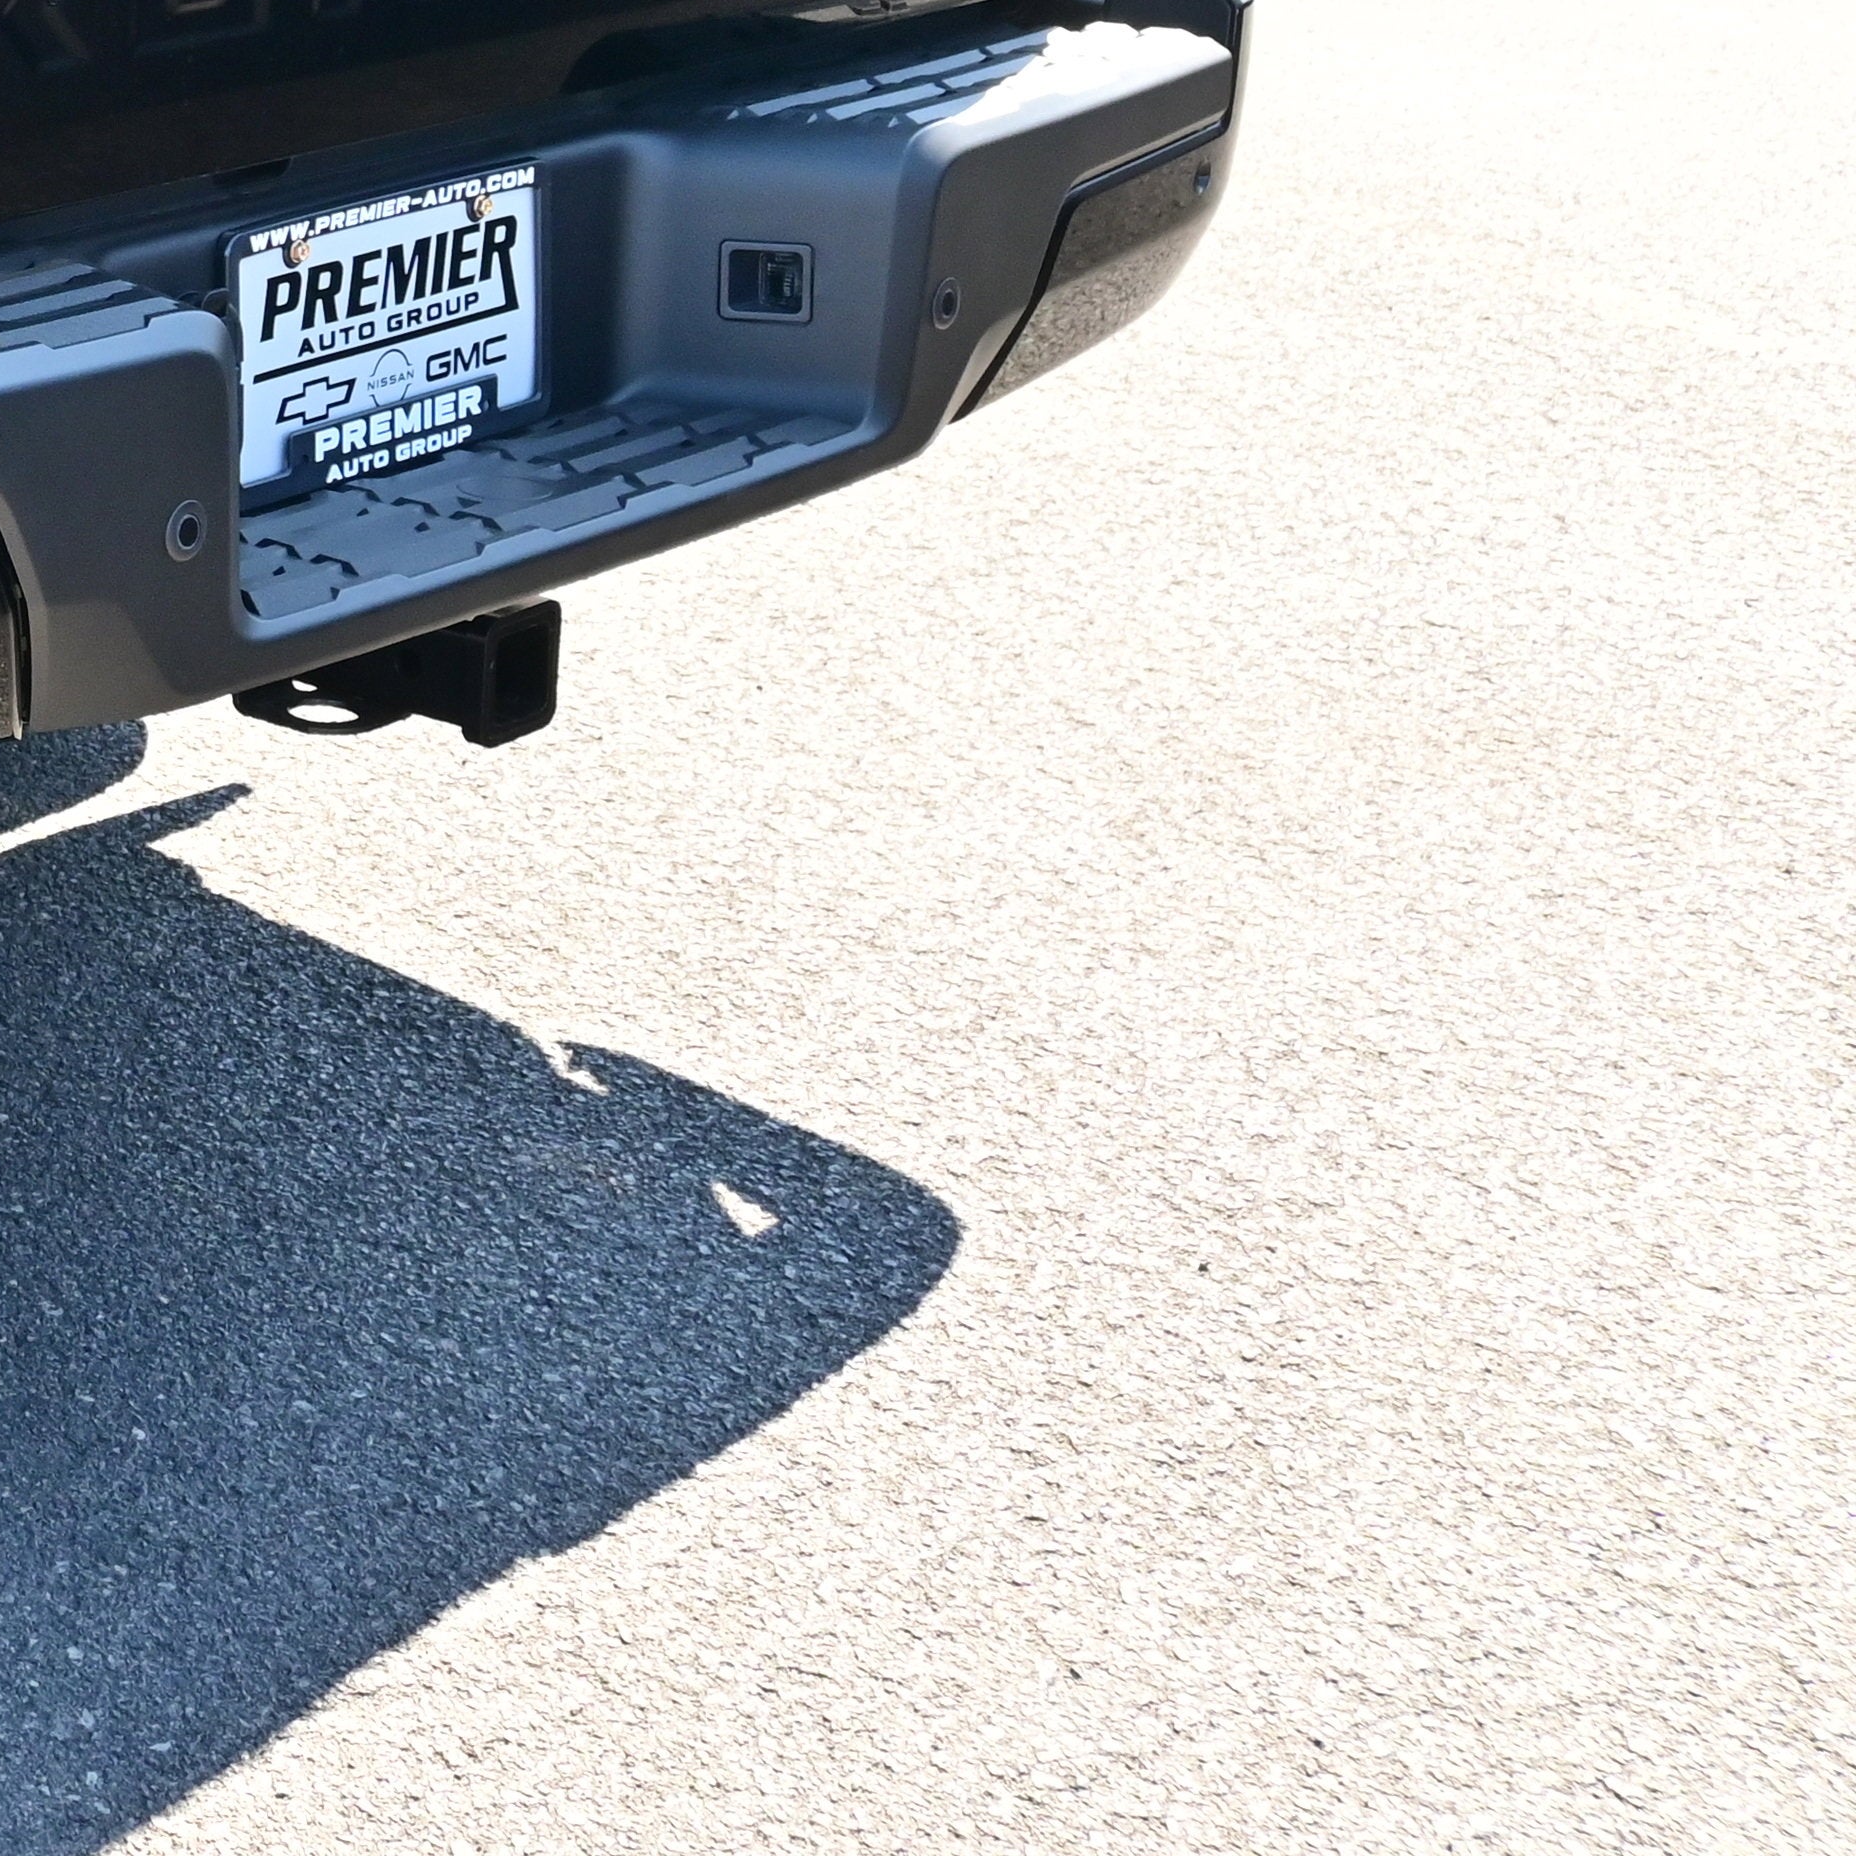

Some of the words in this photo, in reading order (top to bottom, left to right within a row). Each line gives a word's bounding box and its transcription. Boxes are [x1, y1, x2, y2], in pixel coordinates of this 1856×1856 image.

[249, 166, 536, 253] WWW.PREMIER-AUTO.COM
[260, 215, 520, 343] PREMIER
[297, 320, 376, 358] AUTO
[386, 291, 481, 332] GROUP
[367, 369, 416, 392] NISSAN
[425, 334, 508, 383] GMC
[314, 385, 483, 463] PREMIER
[326, 448, 389, 485] AUTO
[395, 424, 474, 462] GROUP
